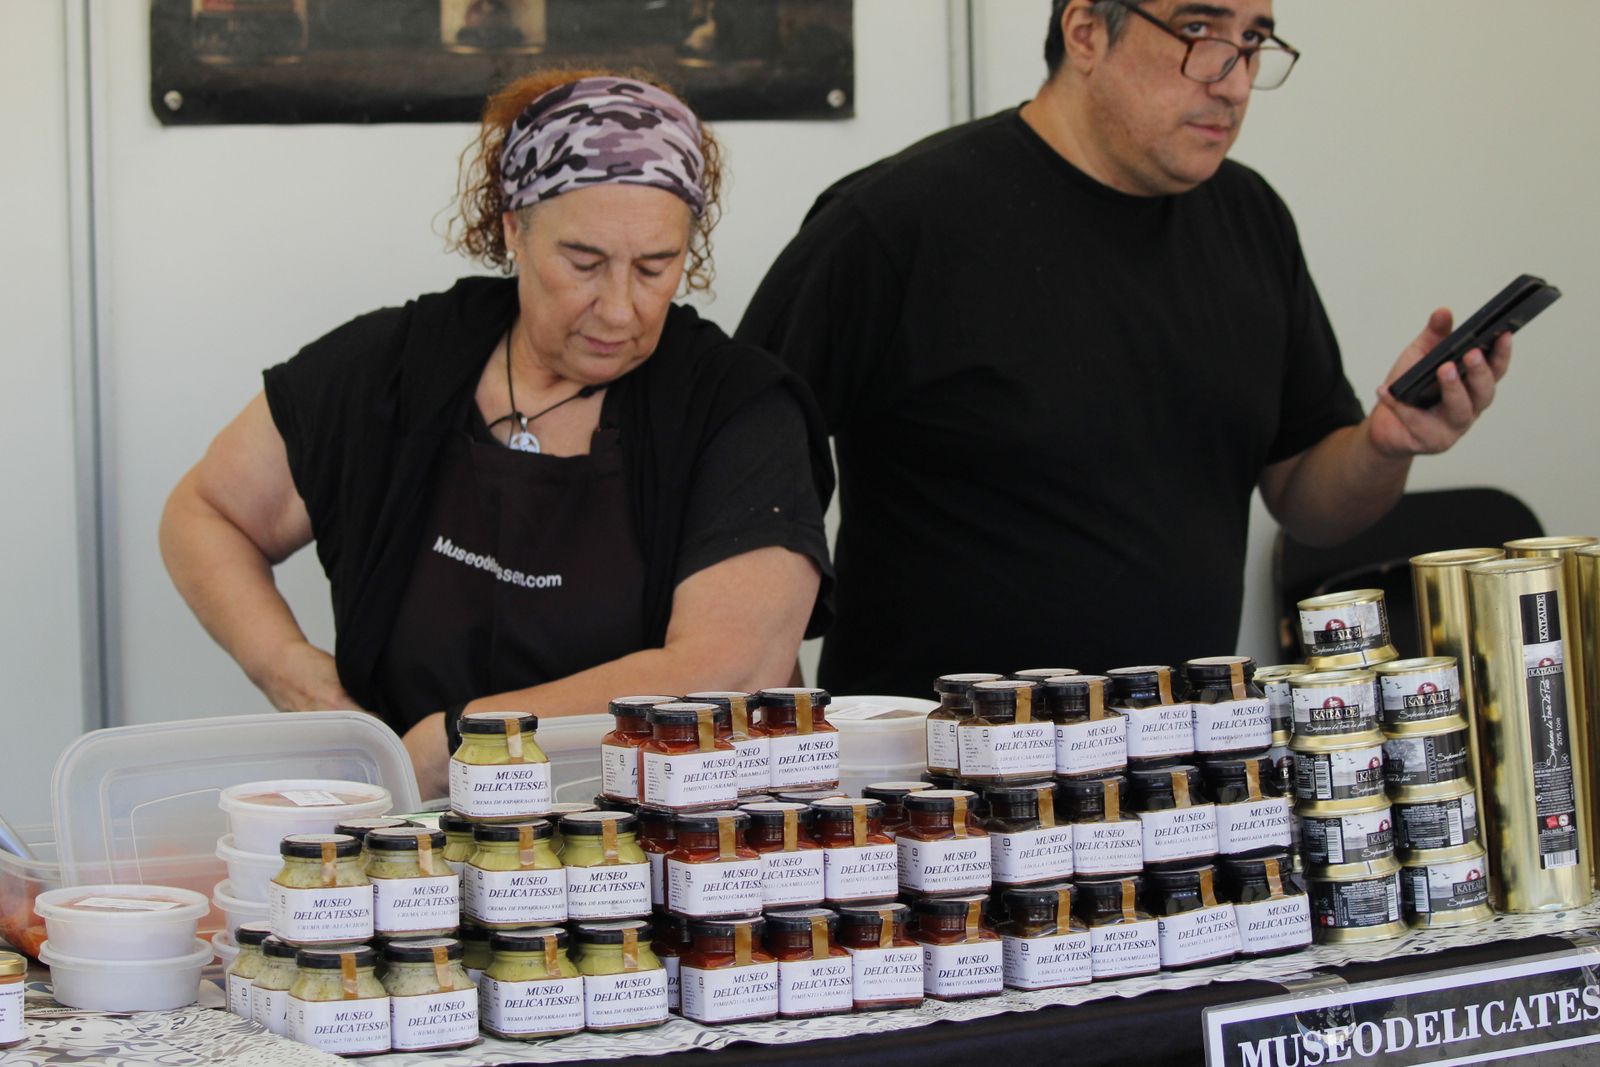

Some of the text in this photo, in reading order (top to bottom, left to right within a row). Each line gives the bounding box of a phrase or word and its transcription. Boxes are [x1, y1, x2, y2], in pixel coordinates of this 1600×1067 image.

[1160, 710, 1188, 720] MUSEO
[1232, 706, 1264, 716] MUSEO
[1313, 706, 1359, 720] KATEADE
[1212, 716, 1272, 730] DELICATESS
[1012, 729, 1043, 738] MUSEO
[1087, 725, 1117, 737] MUSEO
[798, 741, 833, 751] MUSEO
[736, 747, 760, 758] USEO
[702, 758, 735, 770] MUSEO
[737, 758, 769, 769] ATESSE
[495, 770, 533, 780] MUSEO
[1250, 805, 1282, 817] MUSEO
[1172, 812, 1205, 823] MUSEO
[1231, 816, 1289, 832] DELICATESS
[1035, 833, 1066, 846] MUSEO
[1092, 830, 1125, 838] MUSEO
[1075, 840, 1141, 850] DELICATESSEN
[861, 851, 893, 861] MUSEO
[943, 851, 976, 861] MUSEO
[768, 857, 802, 868] MUSEO
[590, 871, 628, 881] MUSEO
[722, 868, 758, 879] MUSEO
[762, 868, 820, 880] LICATESSEN
[510, 877, 548, 886] MUSEO
[569, 881, 646, 893] DELICATESSEN
[413, 885, 449, 895] MUSEO
[489, 888, 563, 898] DELICATESSEN
[313, 897, 351, 908] MUSEO
[293, 909, 369, 920] DELICATESSEN
[1267, 903, 1300, 916] MUSEO
[1195, 910, 1228, 925] MUSEO
[1104, 930, 1138, 941] MUSEO
[1178, 920, 1237, 940] DELICATESS
[1053, 941, 1085, 952] MUSEO
[883, 953, 917, 963] MUSEO
[957, 954, 989, 965] MUSEO
[810, 966, 845, 977] MUSEO
[864, 964, 923, 976] DELICATESS
[614, 977, 651, 989] MUSEO
[733, 971, 768, 984] MUSEO
[791, 976, 852, 990] DELICATESS
[526, 985, 563, 996] MUSEO
[593, 986, 666, 1002] DELICATESSEN
[428, 1001, 465, 1013] MUSEO
[504, 996, 579, 1008] DELICATESSEN
[334, 1011, 373, 1021] MUSEO
[1237, 984, 1600, 1067] MUSEODELICATES
